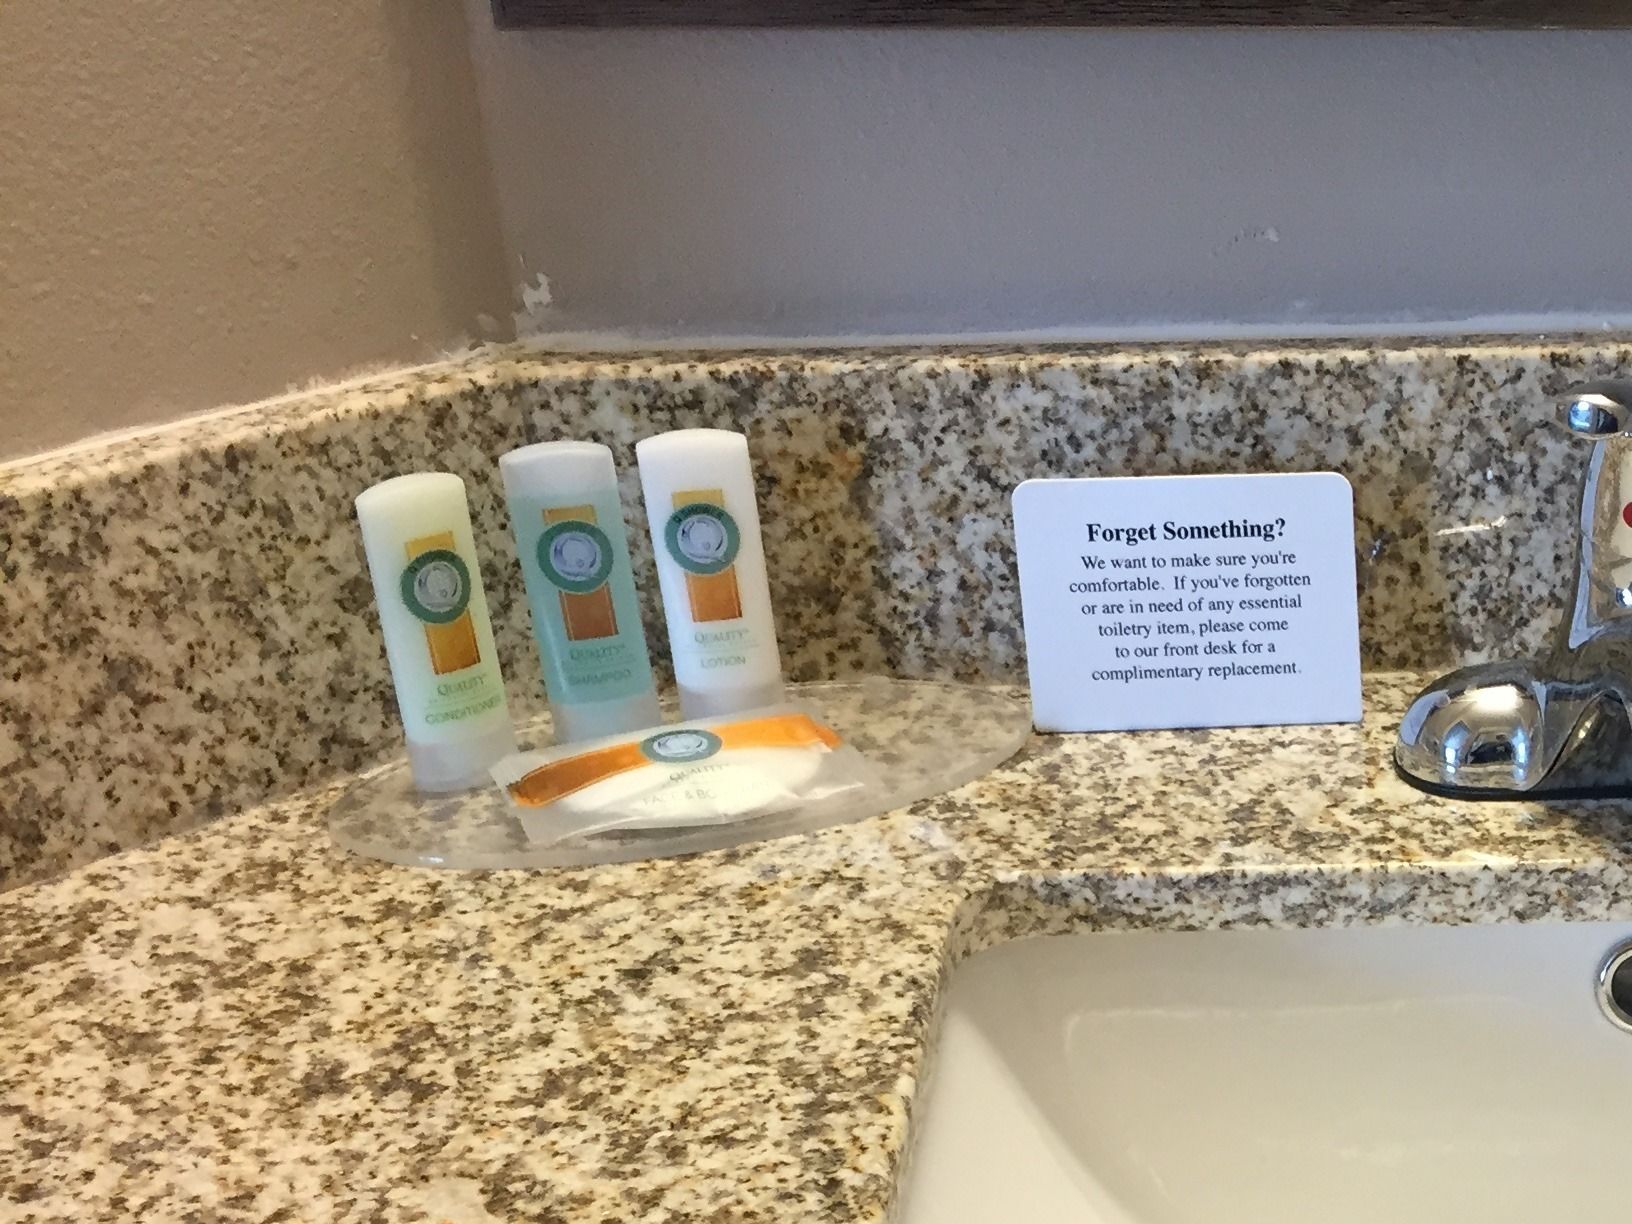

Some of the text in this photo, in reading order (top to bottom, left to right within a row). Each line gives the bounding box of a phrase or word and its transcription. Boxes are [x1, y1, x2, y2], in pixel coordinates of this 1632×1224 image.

[1087, 518, 1286, 546] Forget Something?
[1082, 551, 1296, 569] We want to make sure you're
[1069, 574, 1311, 592] comfortable. If you've forgotten
[1082, 595, 1302, 616] or are in need of any essential
[1099, 619, 1289, 639] toiletry item, please come
[1115, 640, 1275, 658] to our front desk for a
[1092, 664, 1203, 683] complimentary
